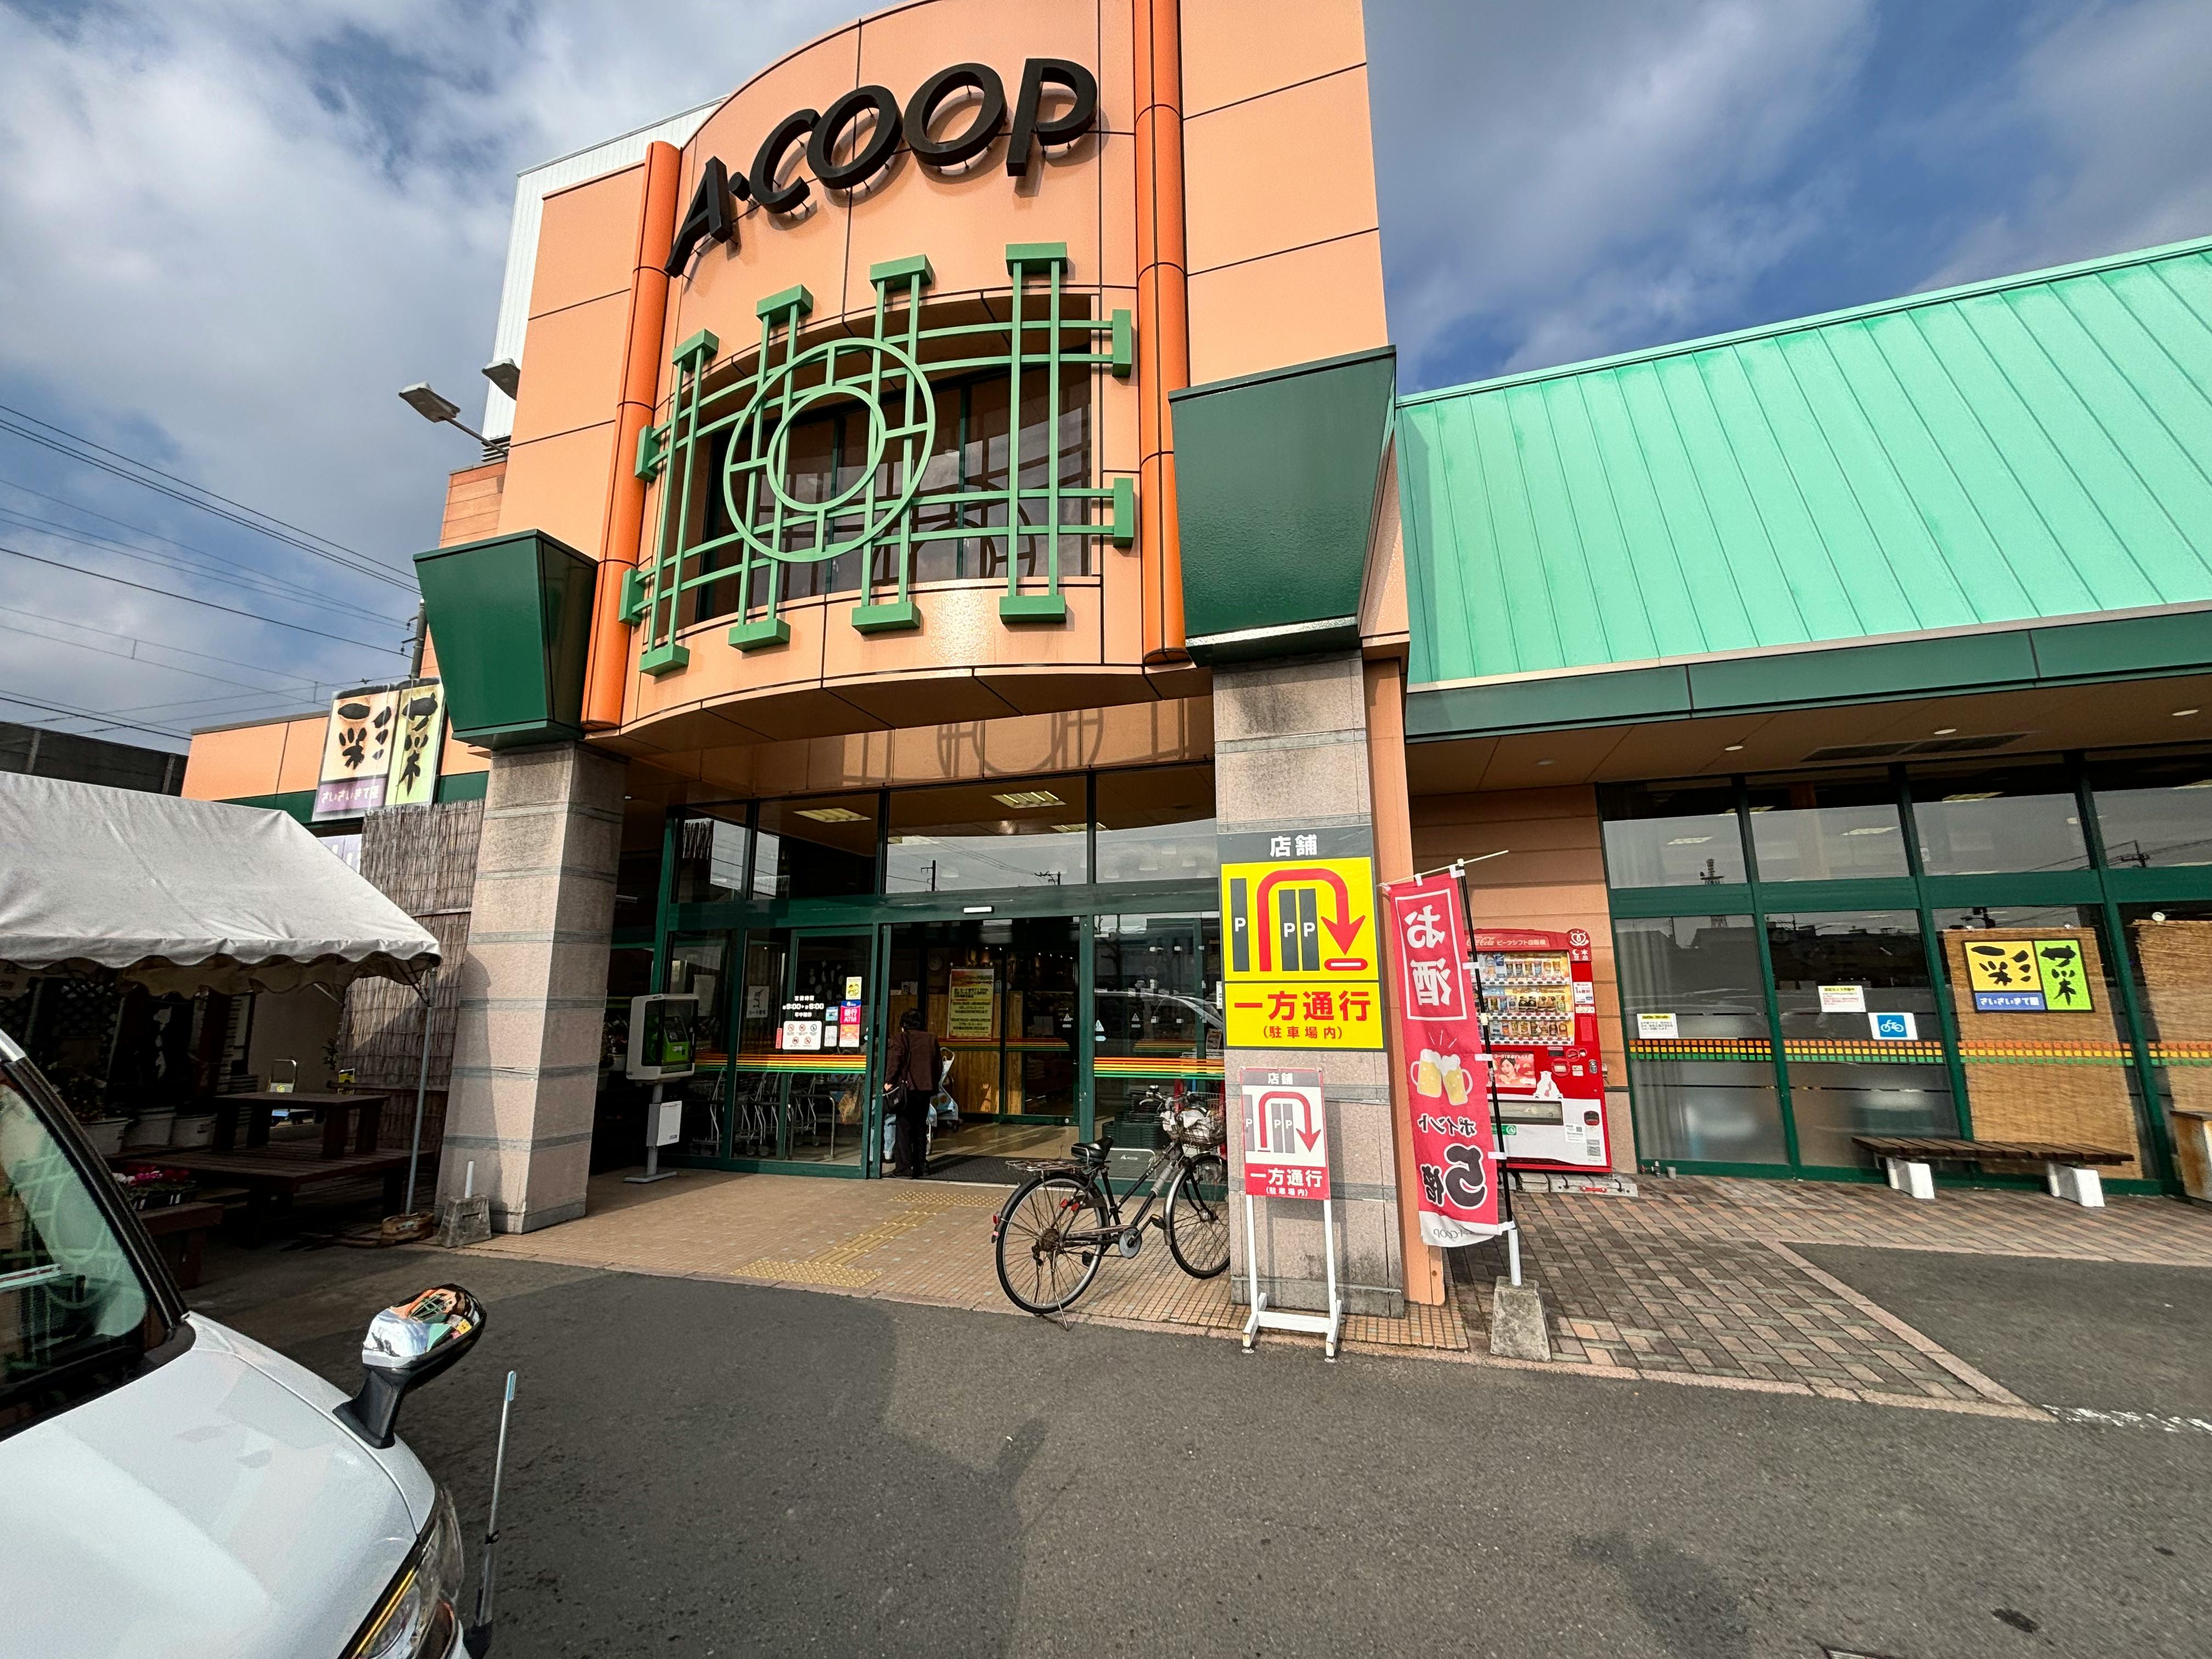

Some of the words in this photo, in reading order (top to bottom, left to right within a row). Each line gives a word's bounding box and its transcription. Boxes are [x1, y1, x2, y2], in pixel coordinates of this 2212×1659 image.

[321, 786, 381, 805] さいさいきて屋
[1269, 834, 1318, 858] 店舗
[1234, 917, 1247, 932] P
[1283, 922, 1295, 938] P
[1302, 921, 1316, 937] P
[1234, 990, 1372, 1022] 一方通行
[1979, 996, 2040, 1007] さいさいきて屋
[1268, 1071, 1294, 1085] 店舗
[1245, 1118, 1252, 1128] P
[1274, 1120, 1281, 1128] P
[1285, 1120, 1293, 1128] P
[1250, 1168, 1323, 1188] 一方通行
